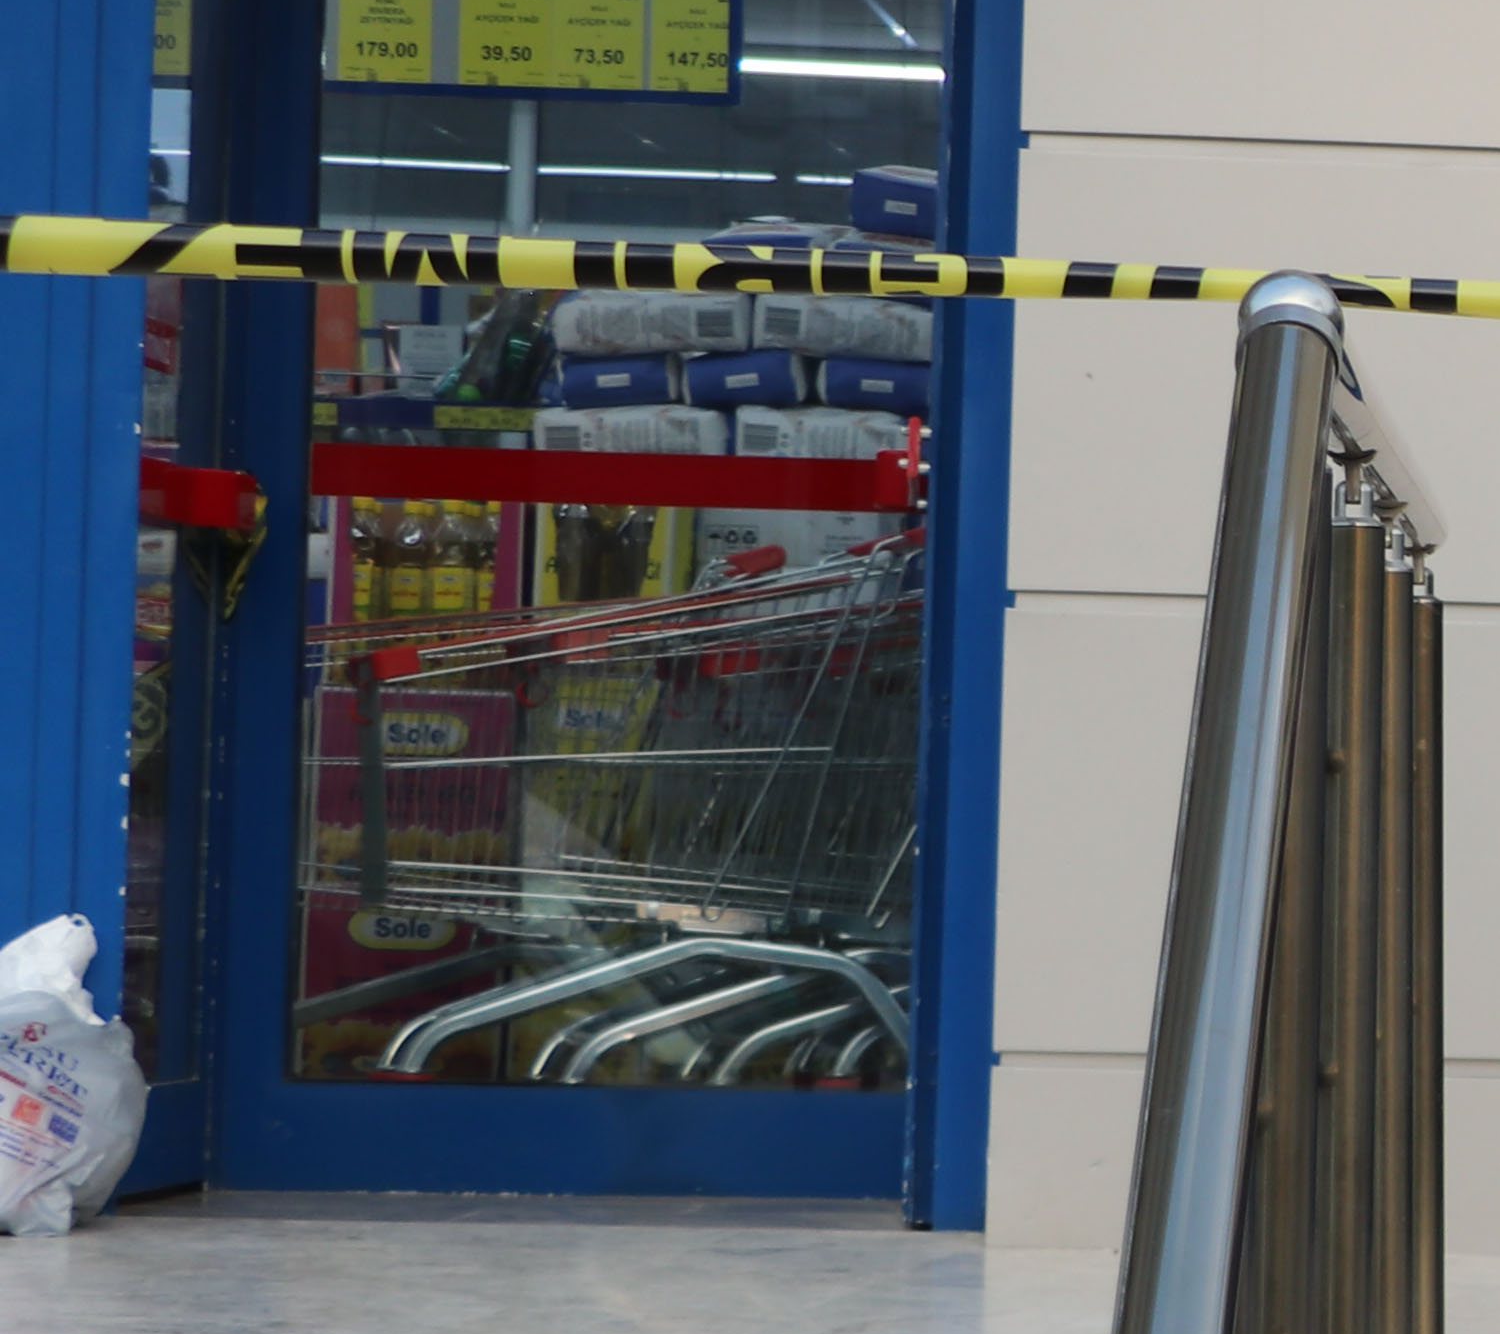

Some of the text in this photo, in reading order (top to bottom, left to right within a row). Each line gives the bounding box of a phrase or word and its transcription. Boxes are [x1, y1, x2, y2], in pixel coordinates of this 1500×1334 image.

[355, 41, 418, 60] 179,00
[481, 45, 533, 63] 39,50
[574, 48, 625, 65] 73,50
[667, 51, 728, 69] 147,50
[374, 916, 432, 939] Sole
